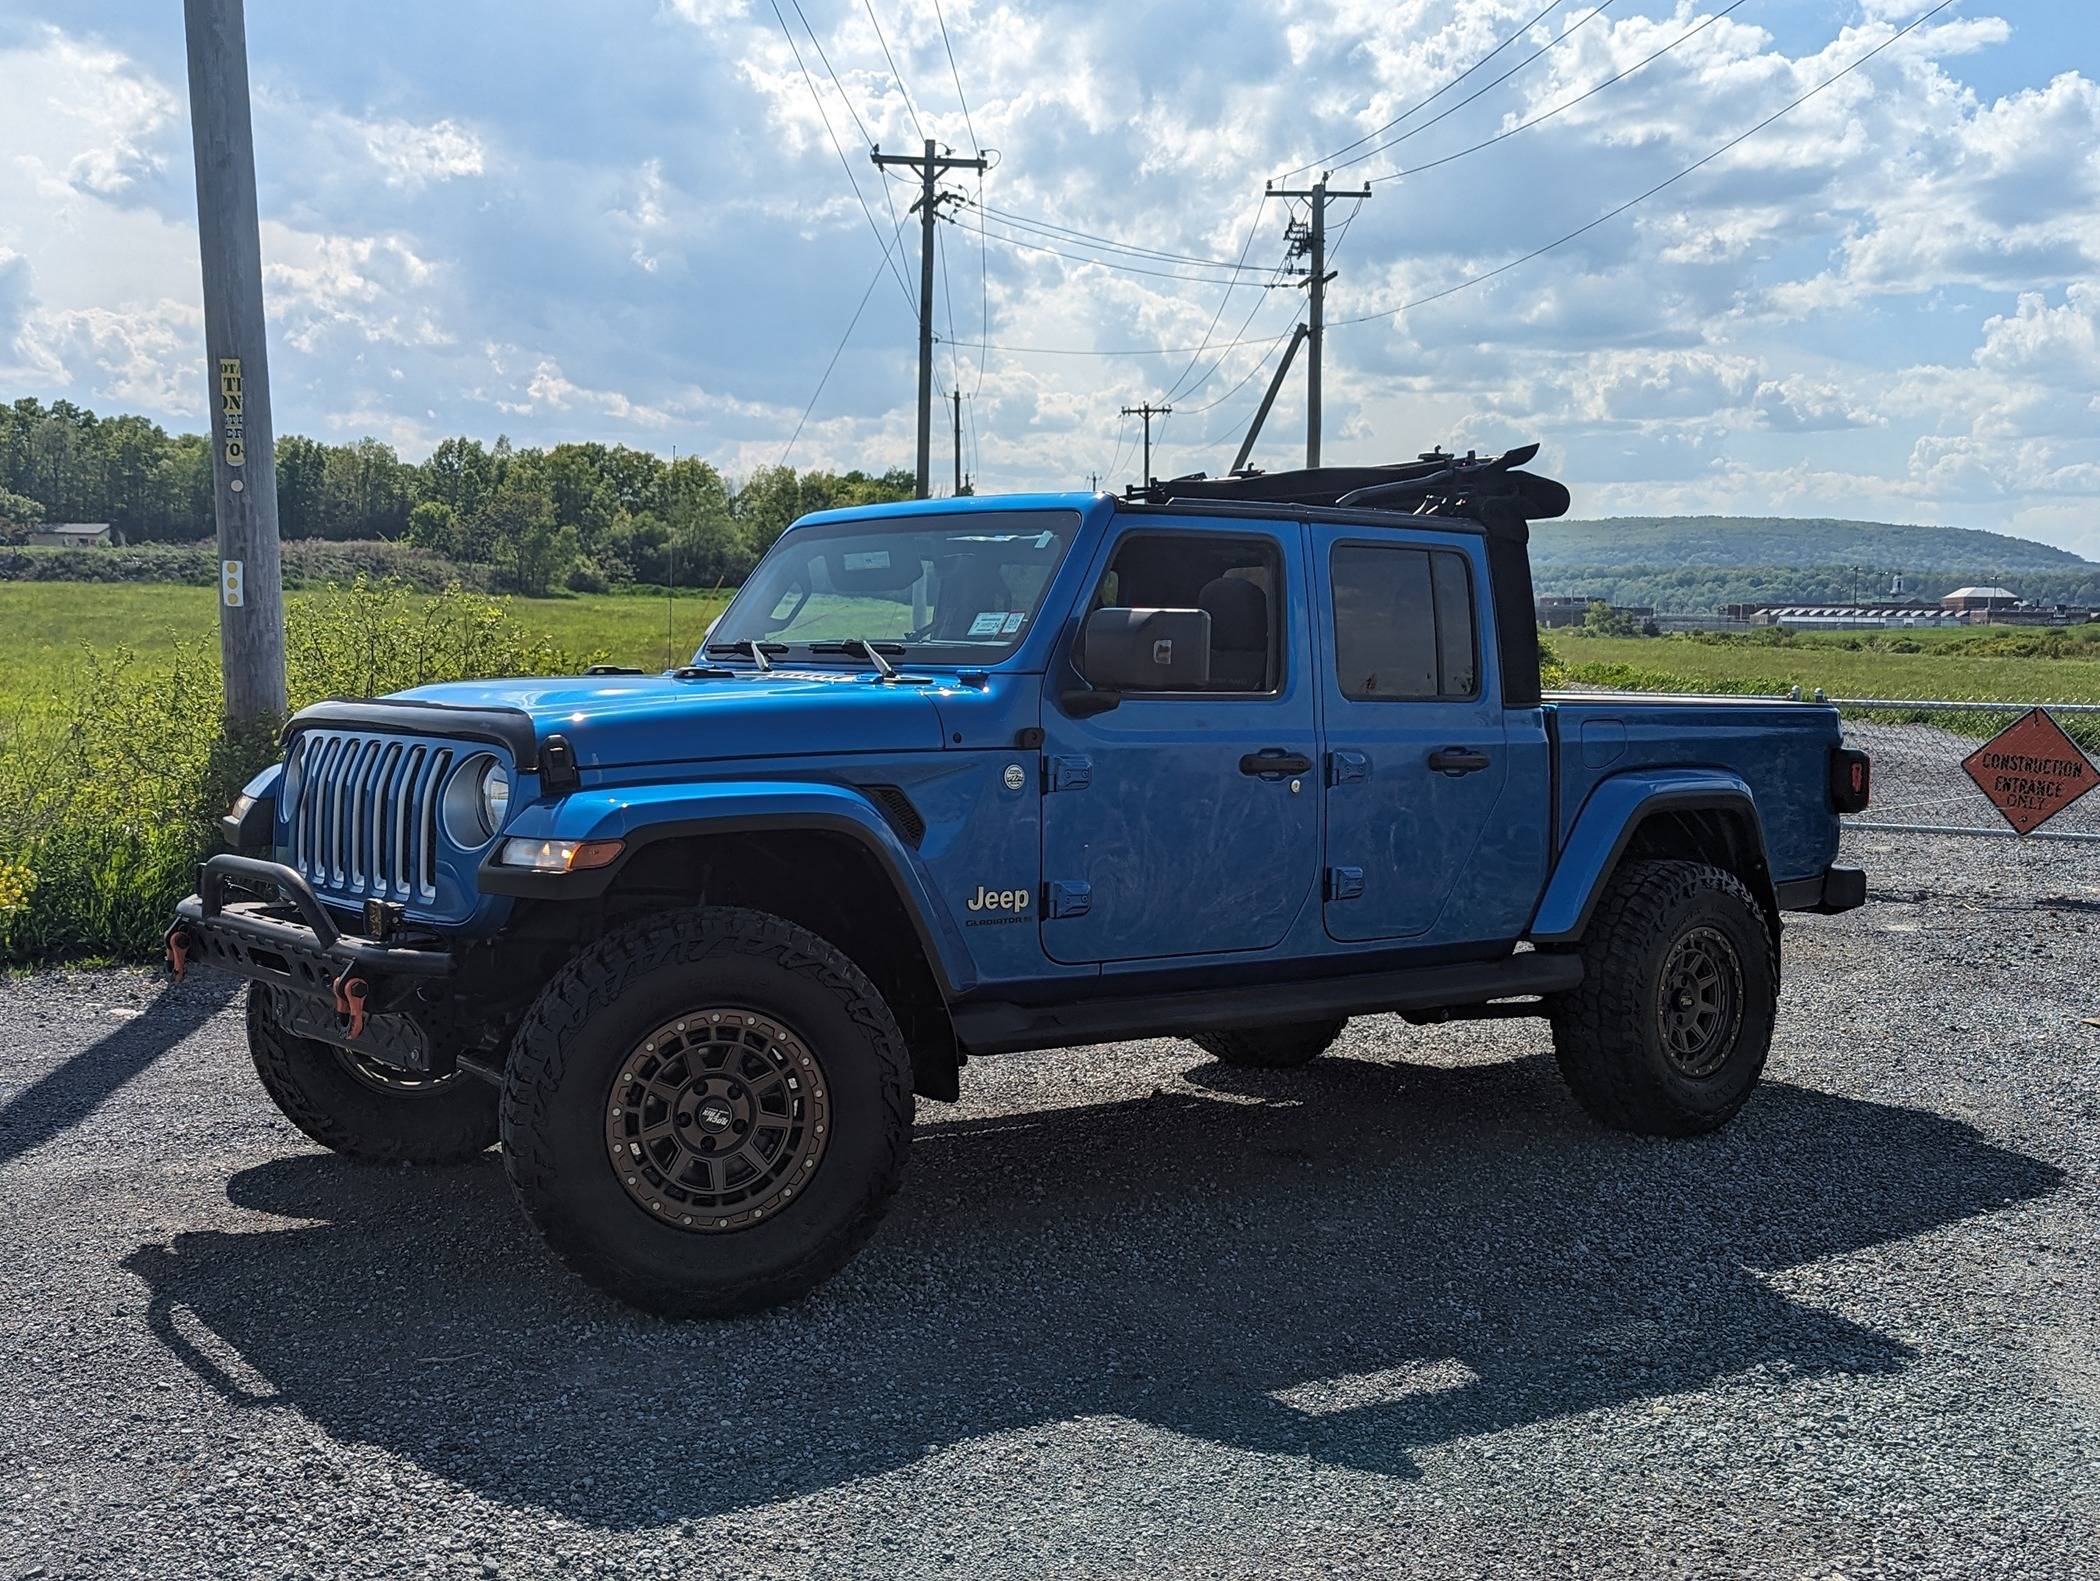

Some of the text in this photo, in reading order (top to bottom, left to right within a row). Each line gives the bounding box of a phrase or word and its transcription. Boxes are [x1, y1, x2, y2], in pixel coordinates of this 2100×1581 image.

[1982, 752, 2083, 778] CONSTRUCTION
[1994, 775, 2065, 798] ENTRANCE
[2006, 794, 2045, 810] ONLY
[967, 886, 1029, 913] Jeep
[965, 917, 1022, 927] GLADIATOR
